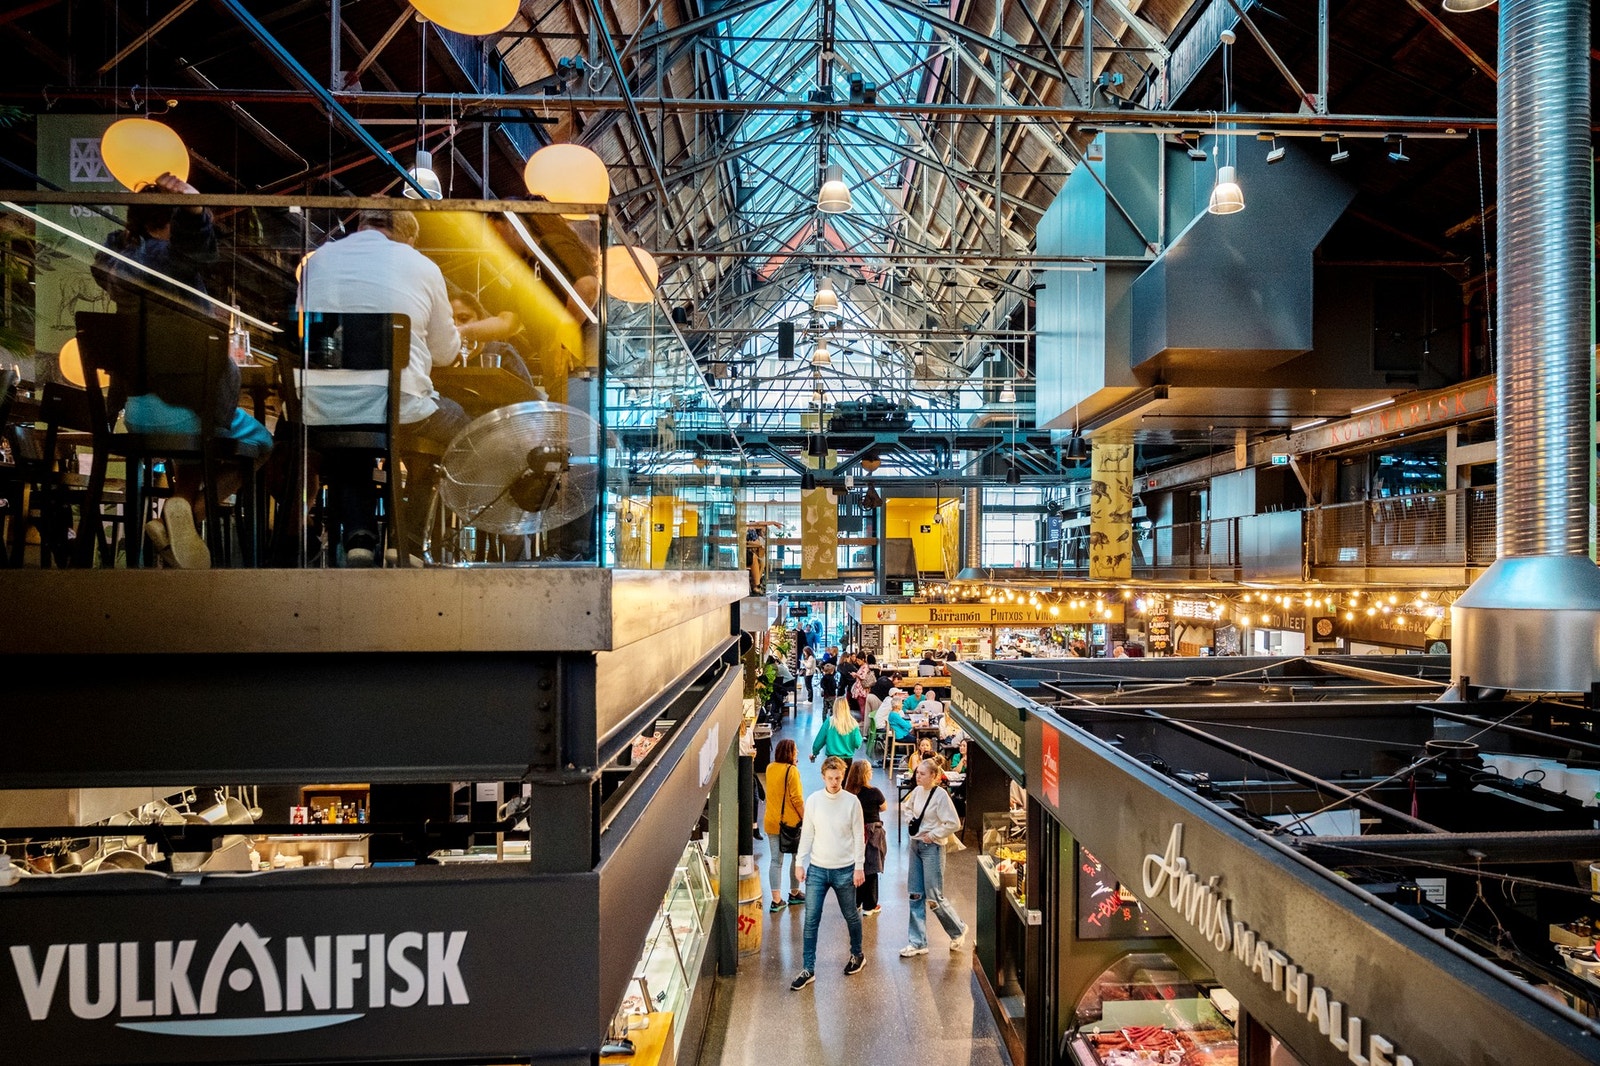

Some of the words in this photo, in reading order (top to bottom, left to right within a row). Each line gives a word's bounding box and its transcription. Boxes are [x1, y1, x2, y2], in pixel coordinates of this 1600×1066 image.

[1331, 392, 1467, 444] KULINARISK
[929, 608, 981, 622] Barramón
[990, 608, 1024, 621] PINTXOS
[1283, 612, 1306, 630] MEET
[9, 922, 470, 1020] VULKANFISK
[1233, 921, 1414, 1066] MATHALLE
